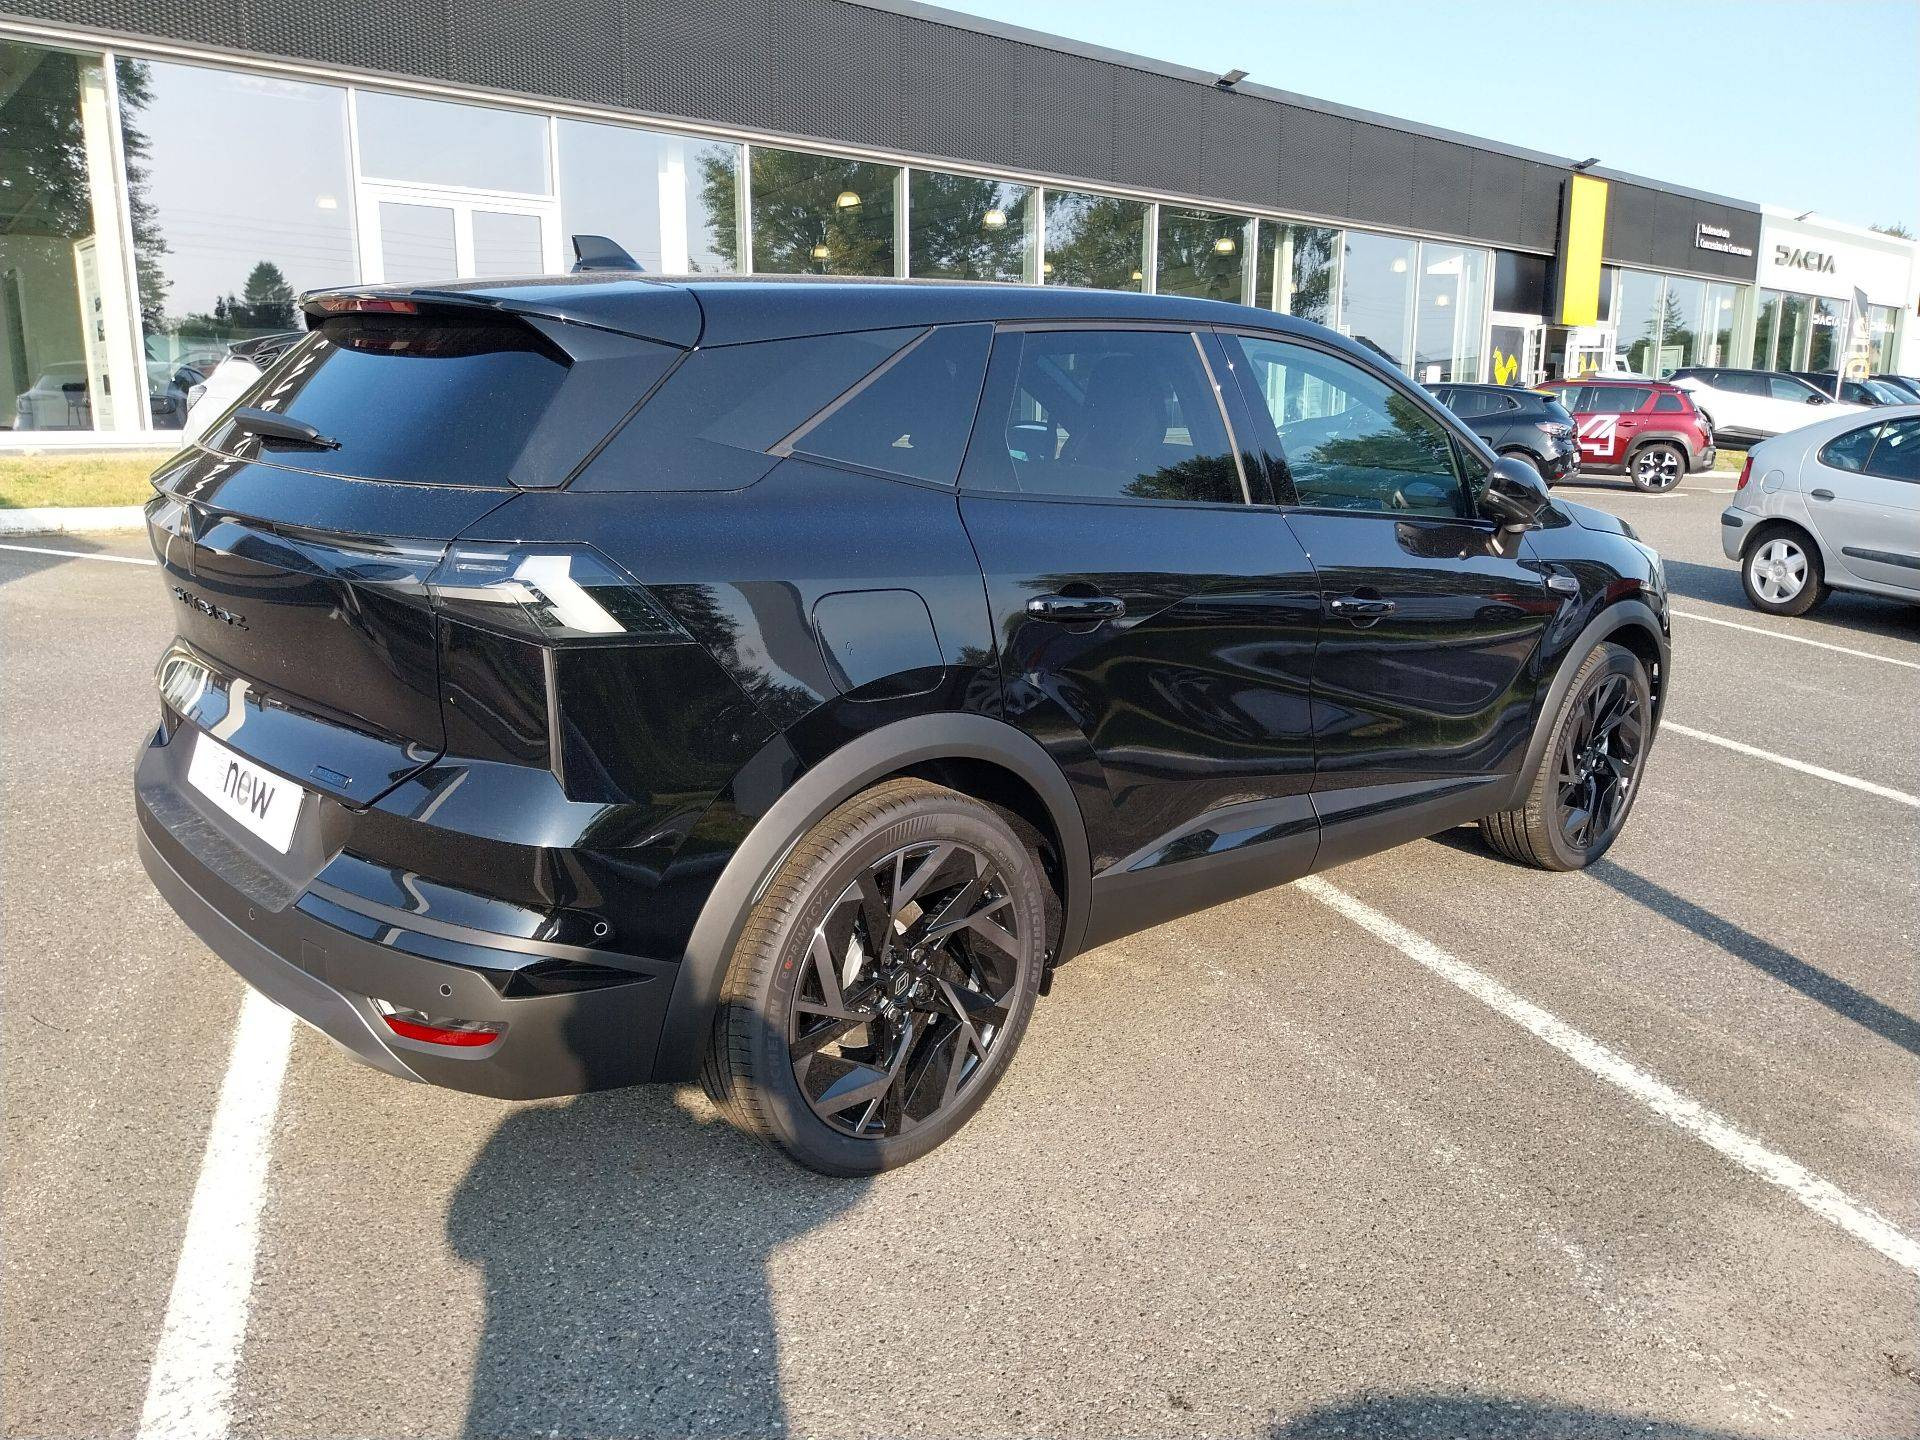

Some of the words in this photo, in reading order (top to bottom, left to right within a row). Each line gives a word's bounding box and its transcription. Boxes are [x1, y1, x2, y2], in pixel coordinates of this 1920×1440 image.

[1775, 244, 1837, 274] DACIA
[223, 760, 276, 820] new
[1027, 891, 1041, 983] MICHELIN
